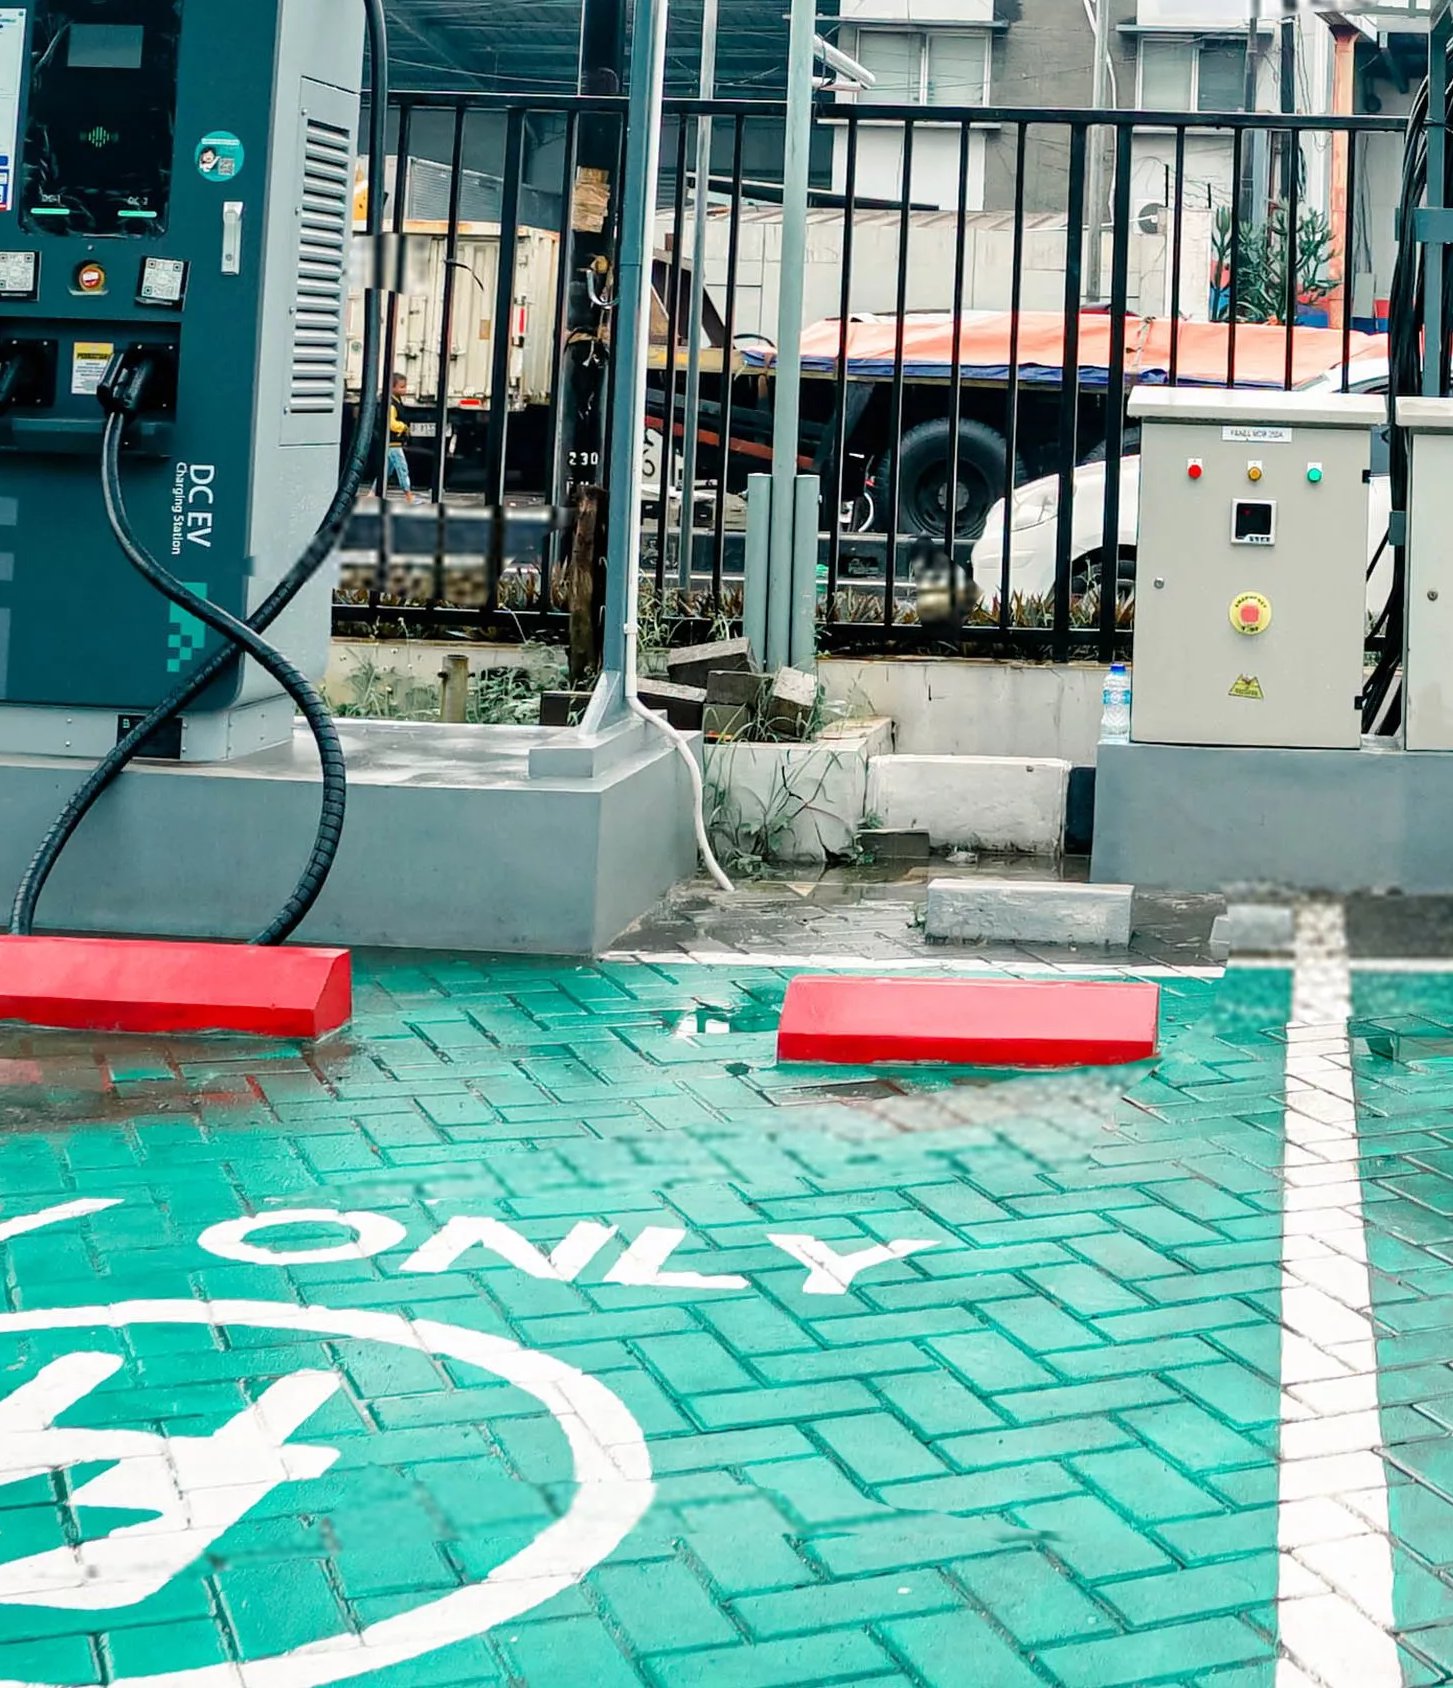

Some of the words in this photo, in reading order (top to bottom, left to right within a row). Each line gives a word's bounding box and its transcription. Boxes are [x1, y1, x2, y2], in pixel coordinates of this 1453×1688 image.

[170, 461, 189, 514] Charging
[188, 464, 216, 505] DC
[171, 514, 185, 555] Station
[186, 511, 214, 548] EV
[197, 1207, 938, 1296] ONLY
